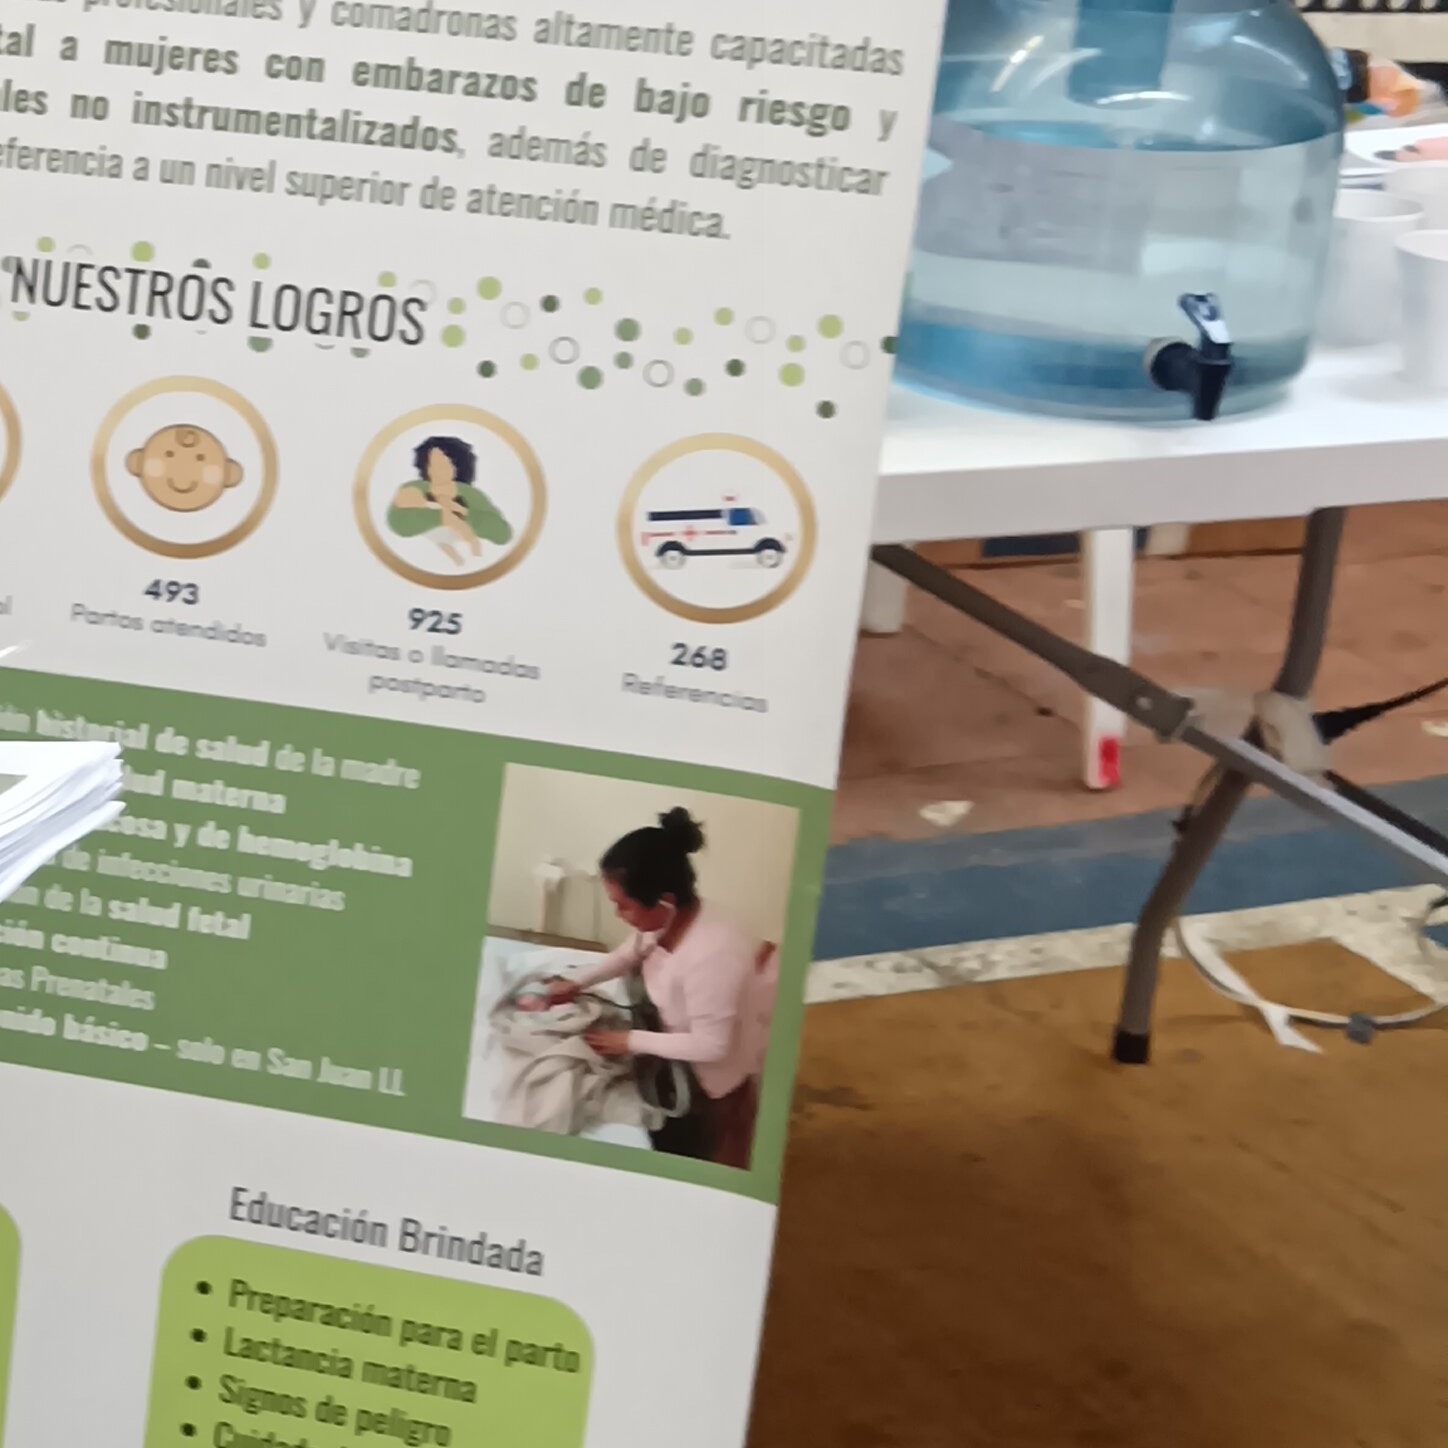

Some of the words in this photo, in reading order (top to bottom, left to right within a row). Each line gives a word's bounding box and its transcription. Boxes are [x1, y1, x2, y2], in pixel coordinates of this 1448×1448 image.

[297, 0, 316, 34] y
[331, 0, 517, 44] comadronas
[534, 13, 694, 58] altamente
[711, 33, 905, 76] capacitadas
[61, 36, 79, 64] a
[104, 36, 239, 78] mujeres
[265, 54, 325, 85] con
[352, 57, 538, 104] embarazos
[566, 72, 607, 110] de
[634, 78, 712, 124] bajo
[738, 89, 851, 136] riesgo
[877, 107, 898, 142] y
[71, 94, 109, 123] no
[132, 91, 465, 161] instrumentalizados,
[488, 127, 607, 170] además
[630, 138, 668, 176] de
[690, 144, 889, 196] diagnosticar
[160, 159, 196, 187] un
[206, 157, 276, 195] nivel
[286, 171, 410, 208] superior
[420, 176, 456, 213] de
[466, 183, 599, 227] atención
[609, 197, 731, 240] médica.
[11, 256, 235, 326] NUESTROS
[249, 280, 427, 346] LOGROS
[71, 603, 142, 631] Partos
[151, 617, 267, 648] atendidos
[144, 578, 200, 605] 493
[409, 608, 462, 634] 925
[323, 632, 400, 660] Visitas
[431, 646, 540, 680] llamadas
[369, 672, 485, 703] postparto
[622, 672, 768, 713] Referencias
[671, 642, 727, 670] 268
[230, 1186, 388, 1247] Educación
[399, 1218, 544, 1276] Brindada
[229, 1279, 392, 1337] Preparación
[400, 1316, 462, 1350] para
[471, 1328, 498, 1357] el
[504, 1335, 580, 1373] parto
[223, 1327, 353, 1378] Lactancia
[362, 1358, 477, 1403] materna
[219, 1374, 306, 1414] Signos
[315, 1395, 347, 1426] de
[355, 1405, 451, 1446] peligro
